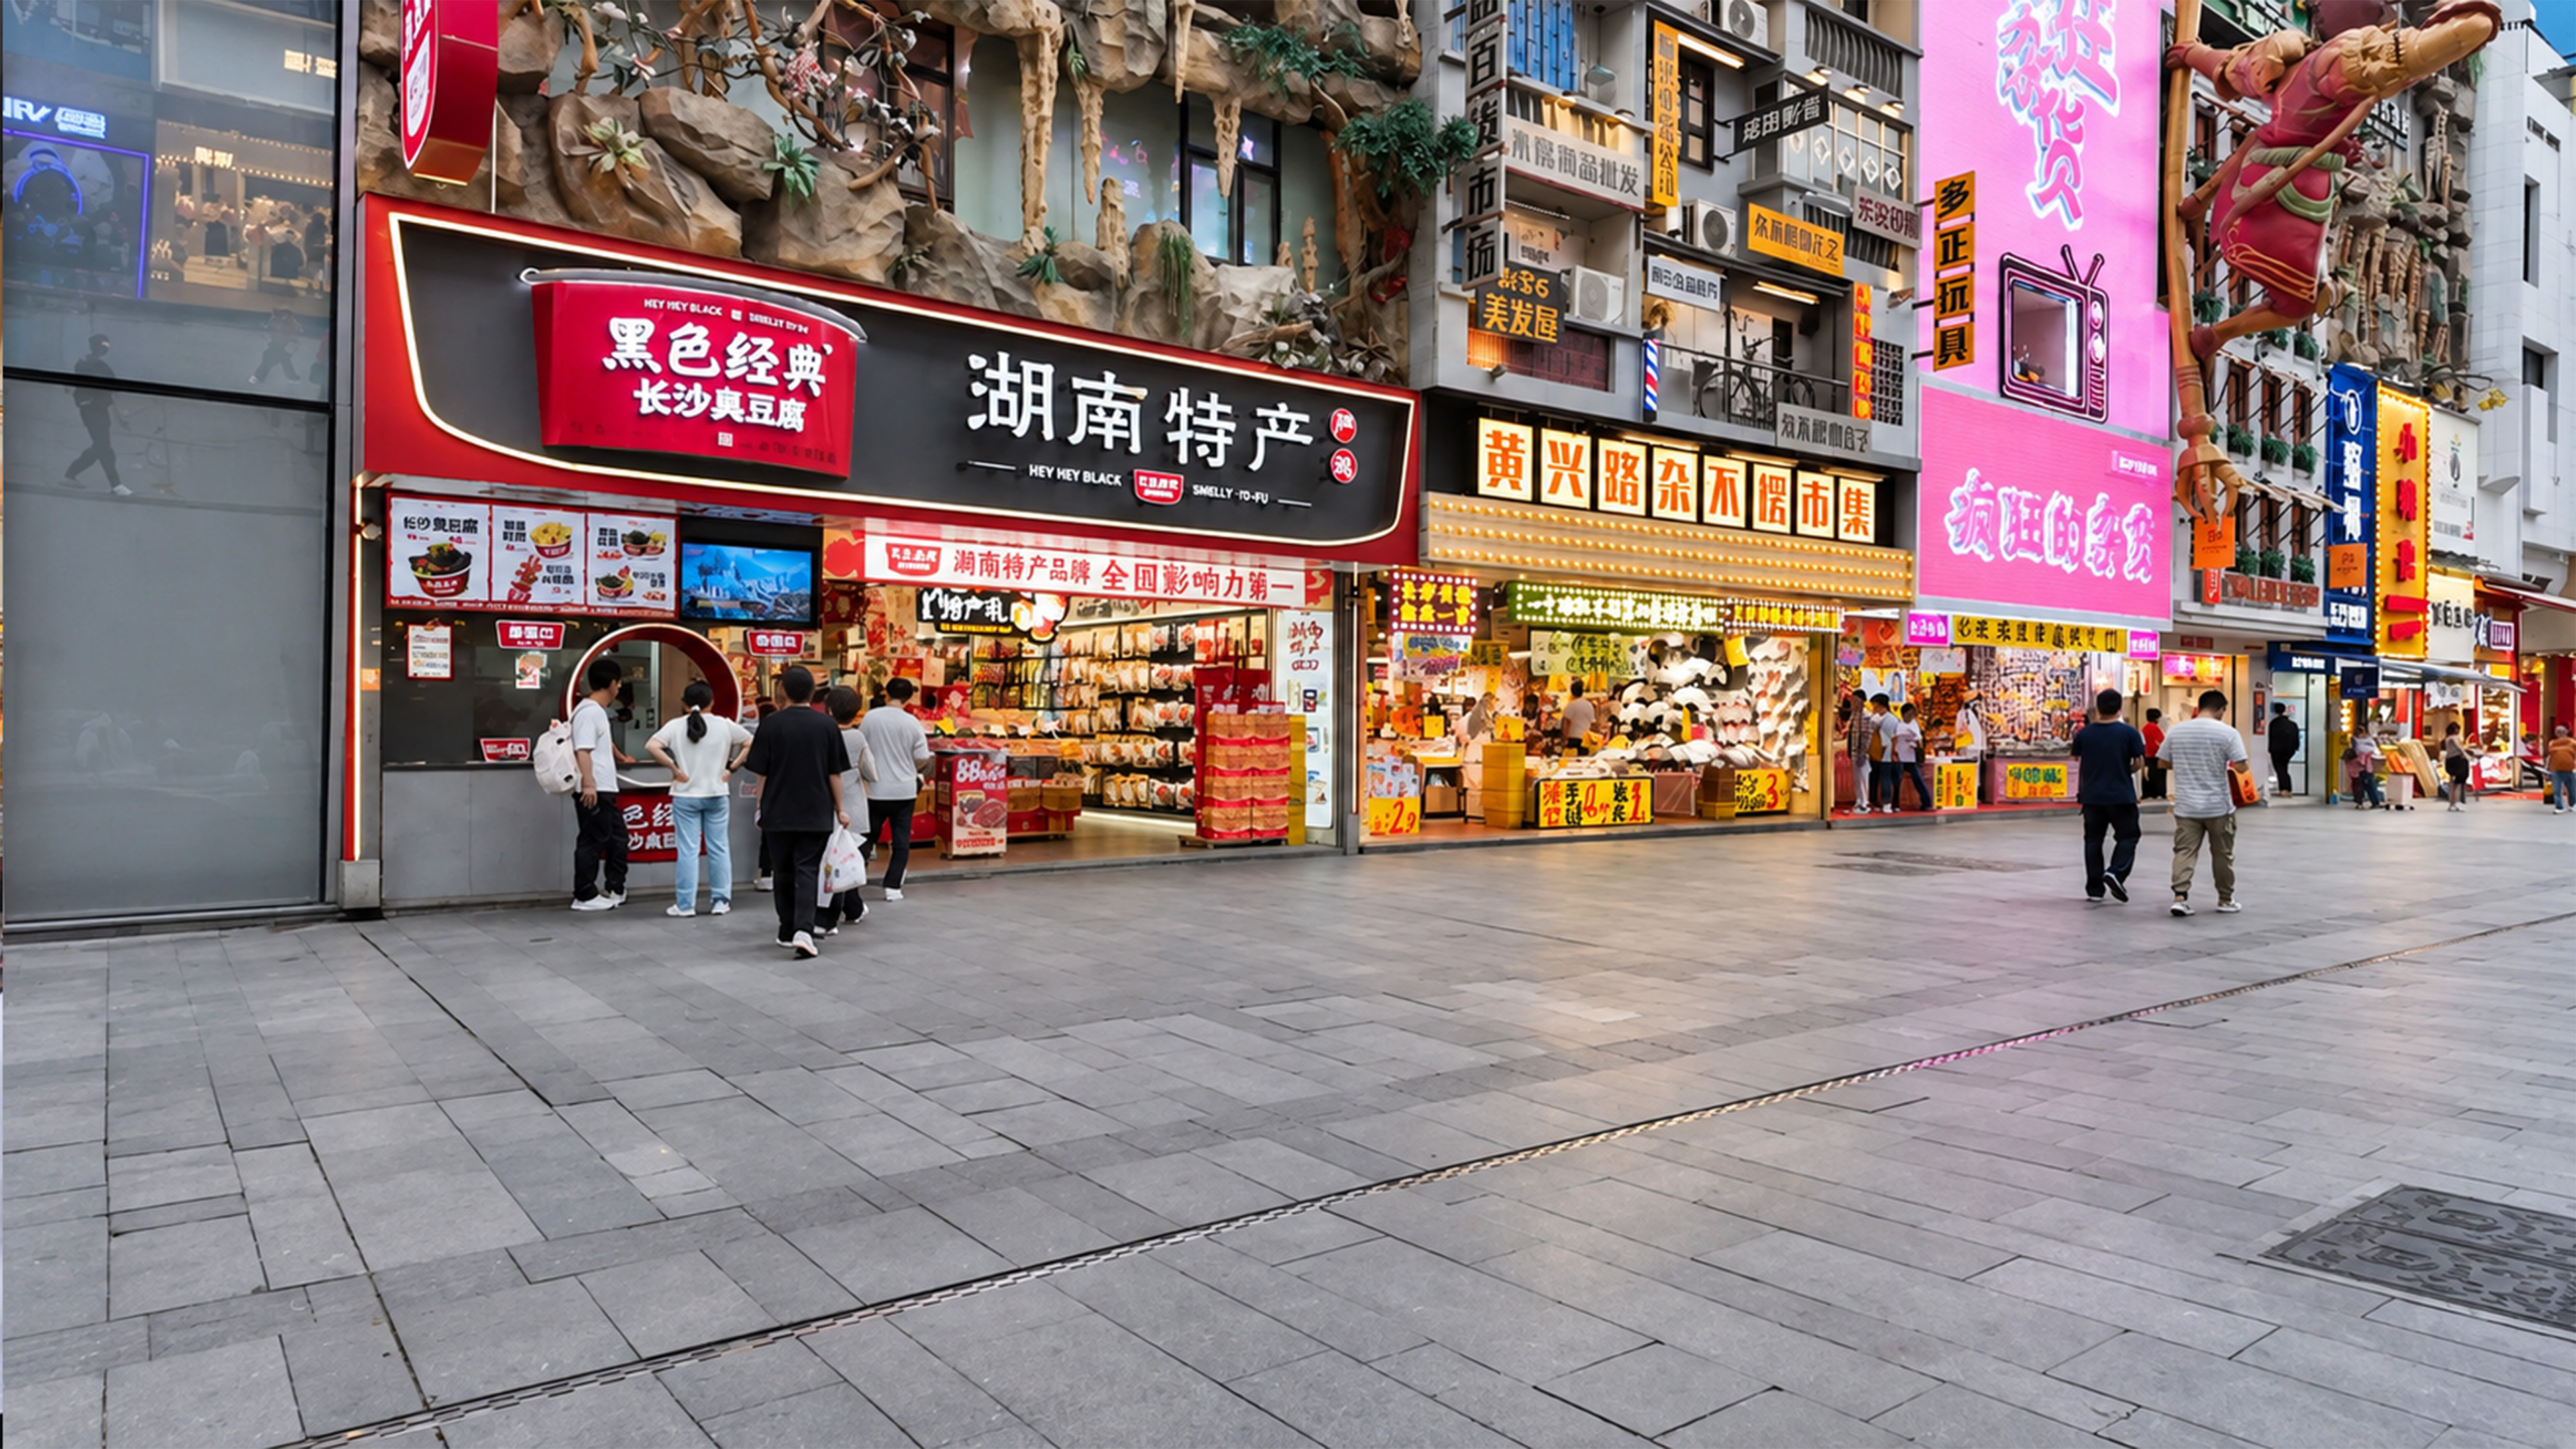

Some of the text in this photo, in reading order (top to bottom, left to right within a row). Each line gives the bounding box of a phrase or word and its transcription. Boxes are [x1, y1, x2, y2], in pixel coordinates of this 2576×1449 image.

[602, 317, 827, 397] 黑色经典
[633, 378, 806, 433] 长沙臭豆腐
[967, 351, 1313, 472] 湖南特产
[1029, 464, 1054, 479] HEY
[1057, 468, 1080, 482] HEY
[1083, 471, 1122, 486] BLACK
[1193, 484, 1233, 500] SMELLY
